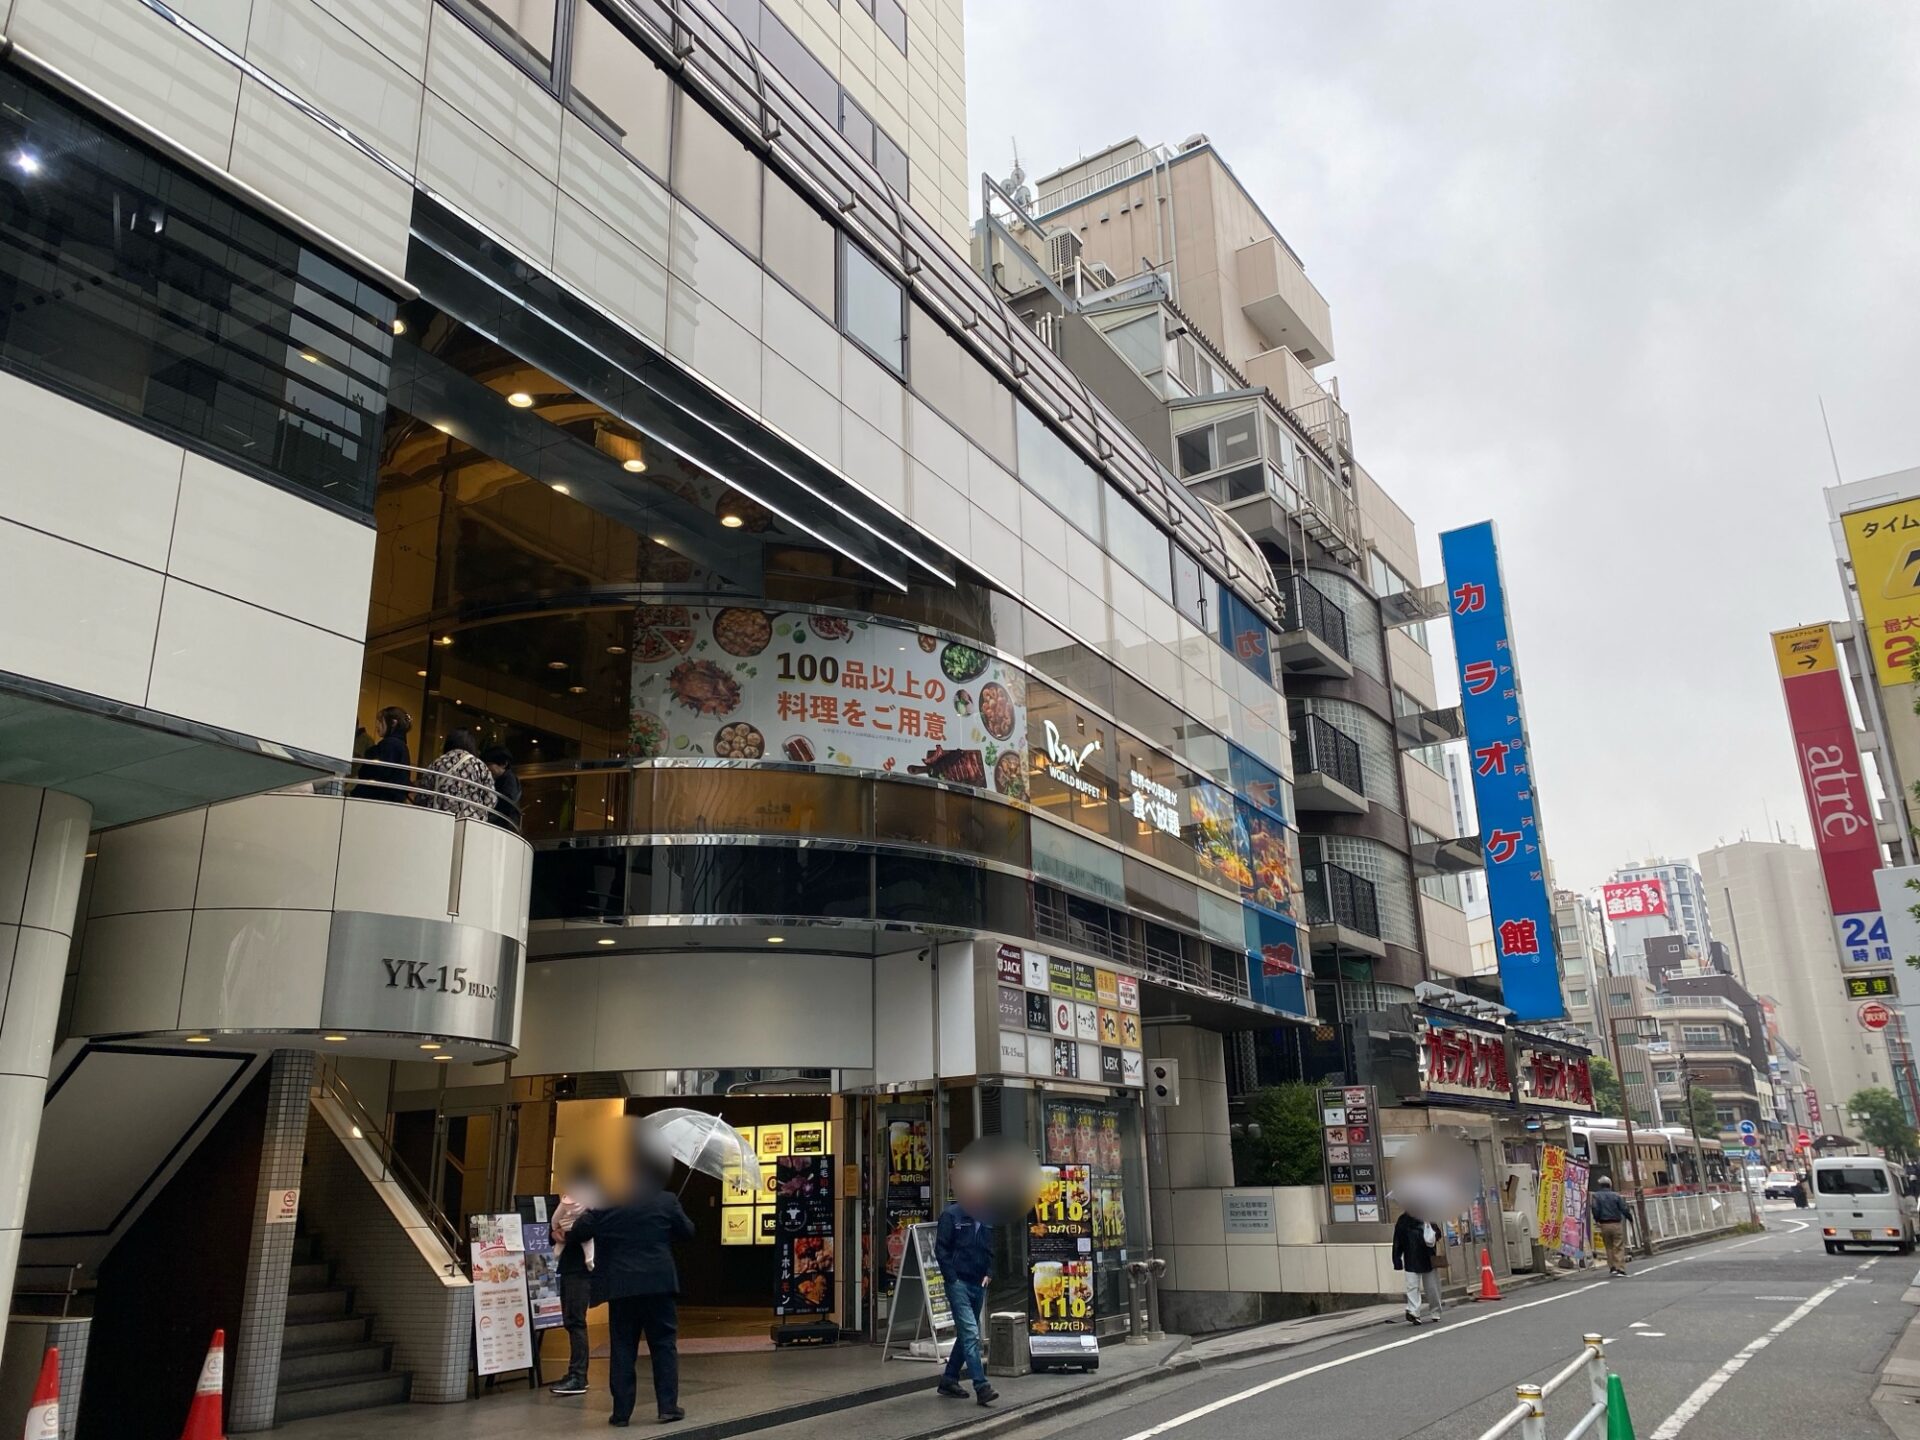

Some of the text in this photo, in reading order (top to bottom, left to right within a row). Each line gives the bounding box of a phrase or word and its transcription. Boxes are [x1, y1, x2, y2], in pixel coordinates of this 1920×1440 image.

[776, 652, 947, 704] 100品以上の
[777, 689, 948, 742] 料理をご用意
[1454, 581, 1539, 957] カラオケ館
[1049, 766, 1100, 799] WORLD BUFFET
[1807, 744, 1869, 838] atré
[1132, 790, 1182, 838] 食べ放題
[1606, 886, 1641, 899] パチンコ
[1842, 915, 1888, 947] 24
[1852, 947, 1892, 962] 時間
[382, 958, 468, 995] YK-15
[1003, 960, 1021, 975] JACK
[1851, 979, 1887, 995] 空車
[1003, 991, 1019, 1002] マシン
[1000, 1002, 1023, 1017] ピラティス
[1029, 1011, 1047, 1025] EXPA
[1103, 1055, 1119, 1071] UBX
[1355, 1168, 1371, 1176] UBX
[1038, 1201, 1083, 1221] 110
[532, 1226, 547, 1237] マシ
[1041, 1297, 1086, 1318] 110
